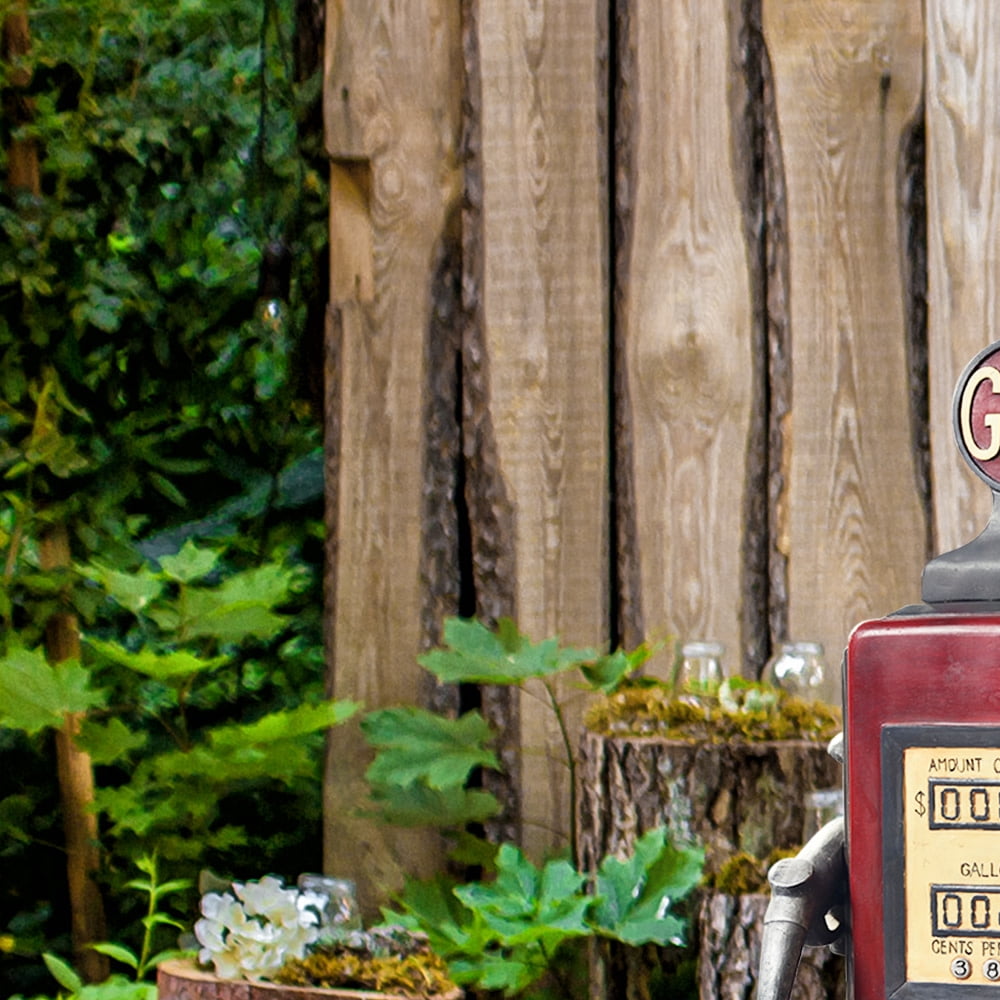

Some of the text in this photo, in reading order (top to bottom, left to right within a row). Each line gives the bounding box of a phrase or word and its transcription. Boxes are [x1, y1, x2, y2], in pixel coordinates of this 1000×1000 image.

[928, 757, 982, 773] AMOUNT
[914, 790, 926, 817] $
[931, 940, 973, 955] CENTS
